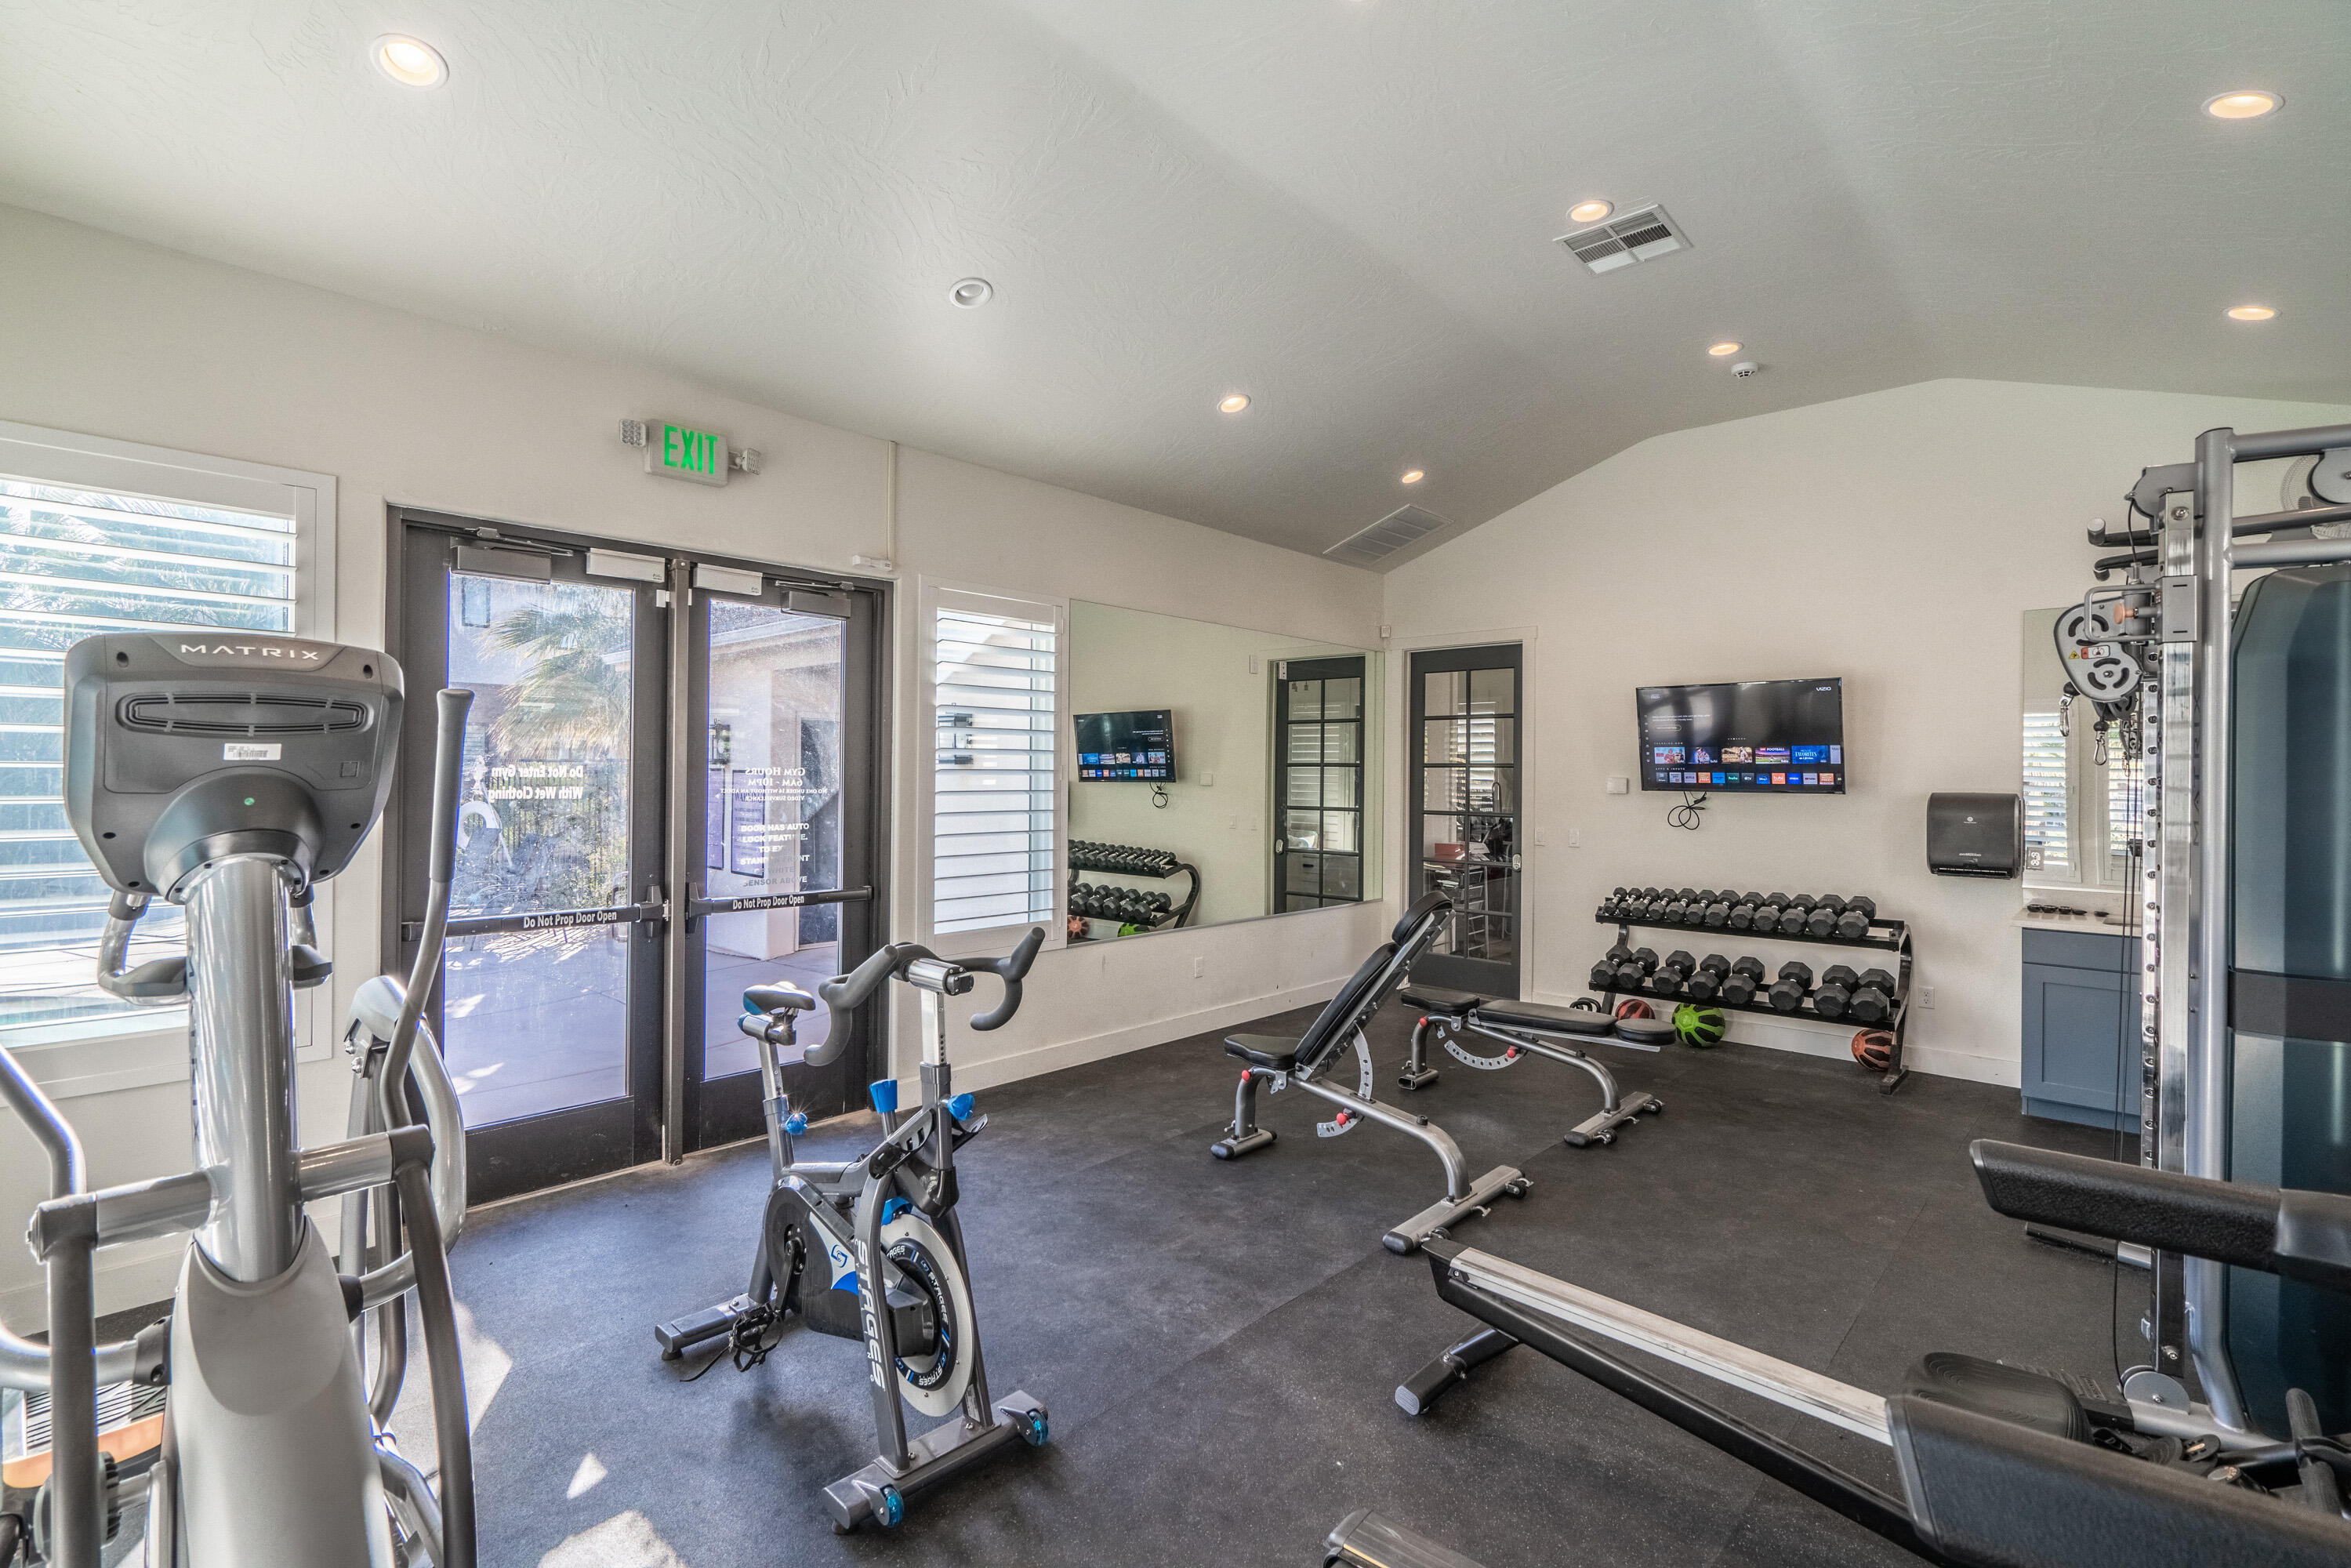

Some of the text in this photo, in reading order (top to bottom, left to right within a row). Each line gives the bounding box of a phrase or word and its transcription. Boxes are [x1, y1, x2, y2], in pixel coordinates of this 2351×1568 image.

[664, 424, 718, 474] EXIT
[181, 644, 318, 660] MATRIX
[732, 895, 804, 910] Do Not Prop Door Open
[524, 911, 617, 929] Do Not Prop Door Open
[887, 1245, 905, 1259] AGES
[858, 1240, 886, 1392] STAGES
[919, 1365, 942, 1386] STAGES
